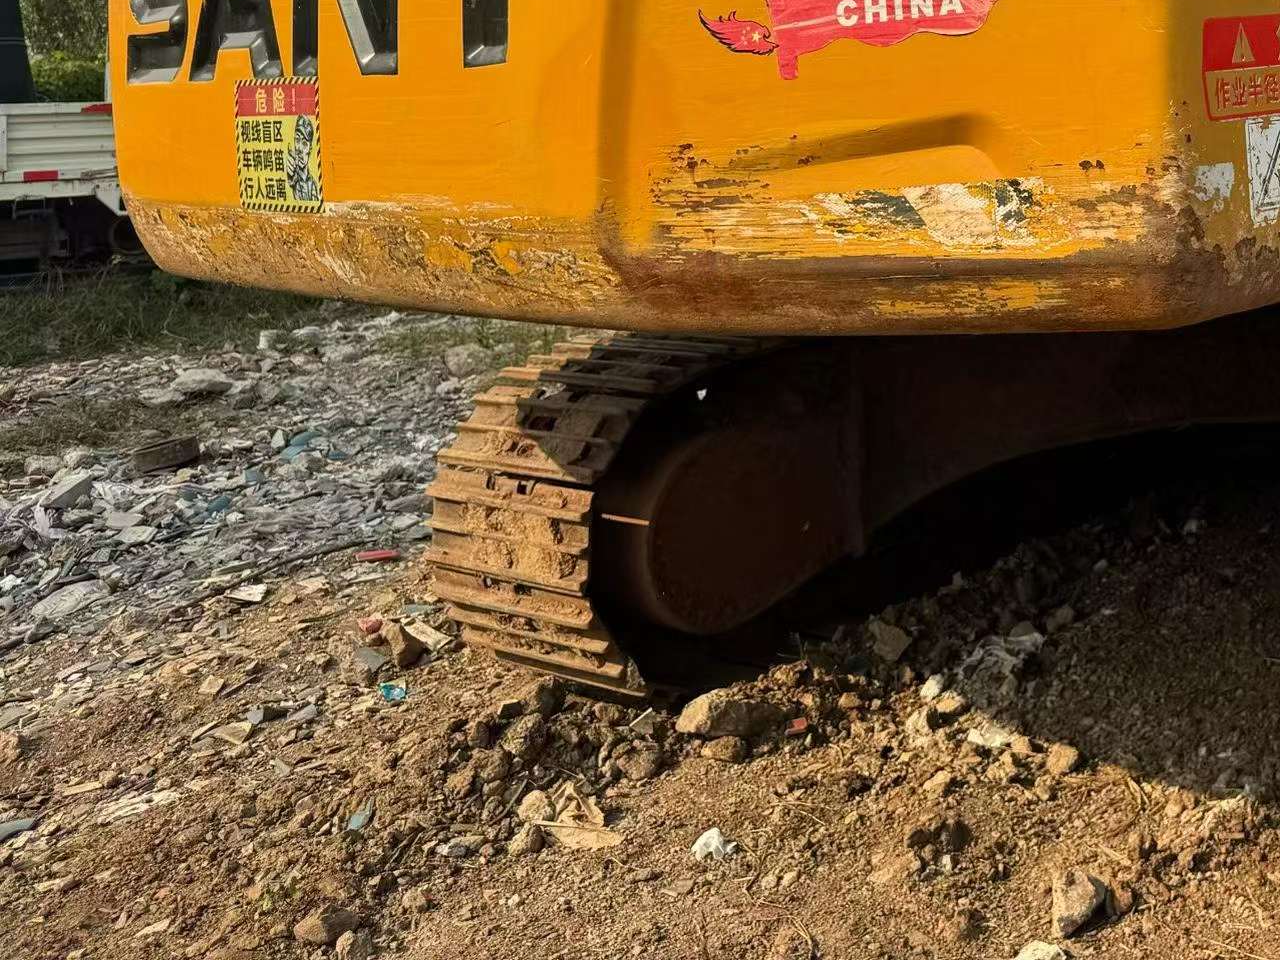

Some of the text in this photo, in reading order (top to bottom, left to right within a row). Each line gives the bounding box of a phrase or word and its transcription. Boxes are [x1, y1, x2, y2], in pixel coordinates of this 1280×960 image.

[240, 120, 284, 143] 视线盲区
[242, 149, 285, 172] 车辆鸣笛
[243, 176, 287, 201] 行人远离
